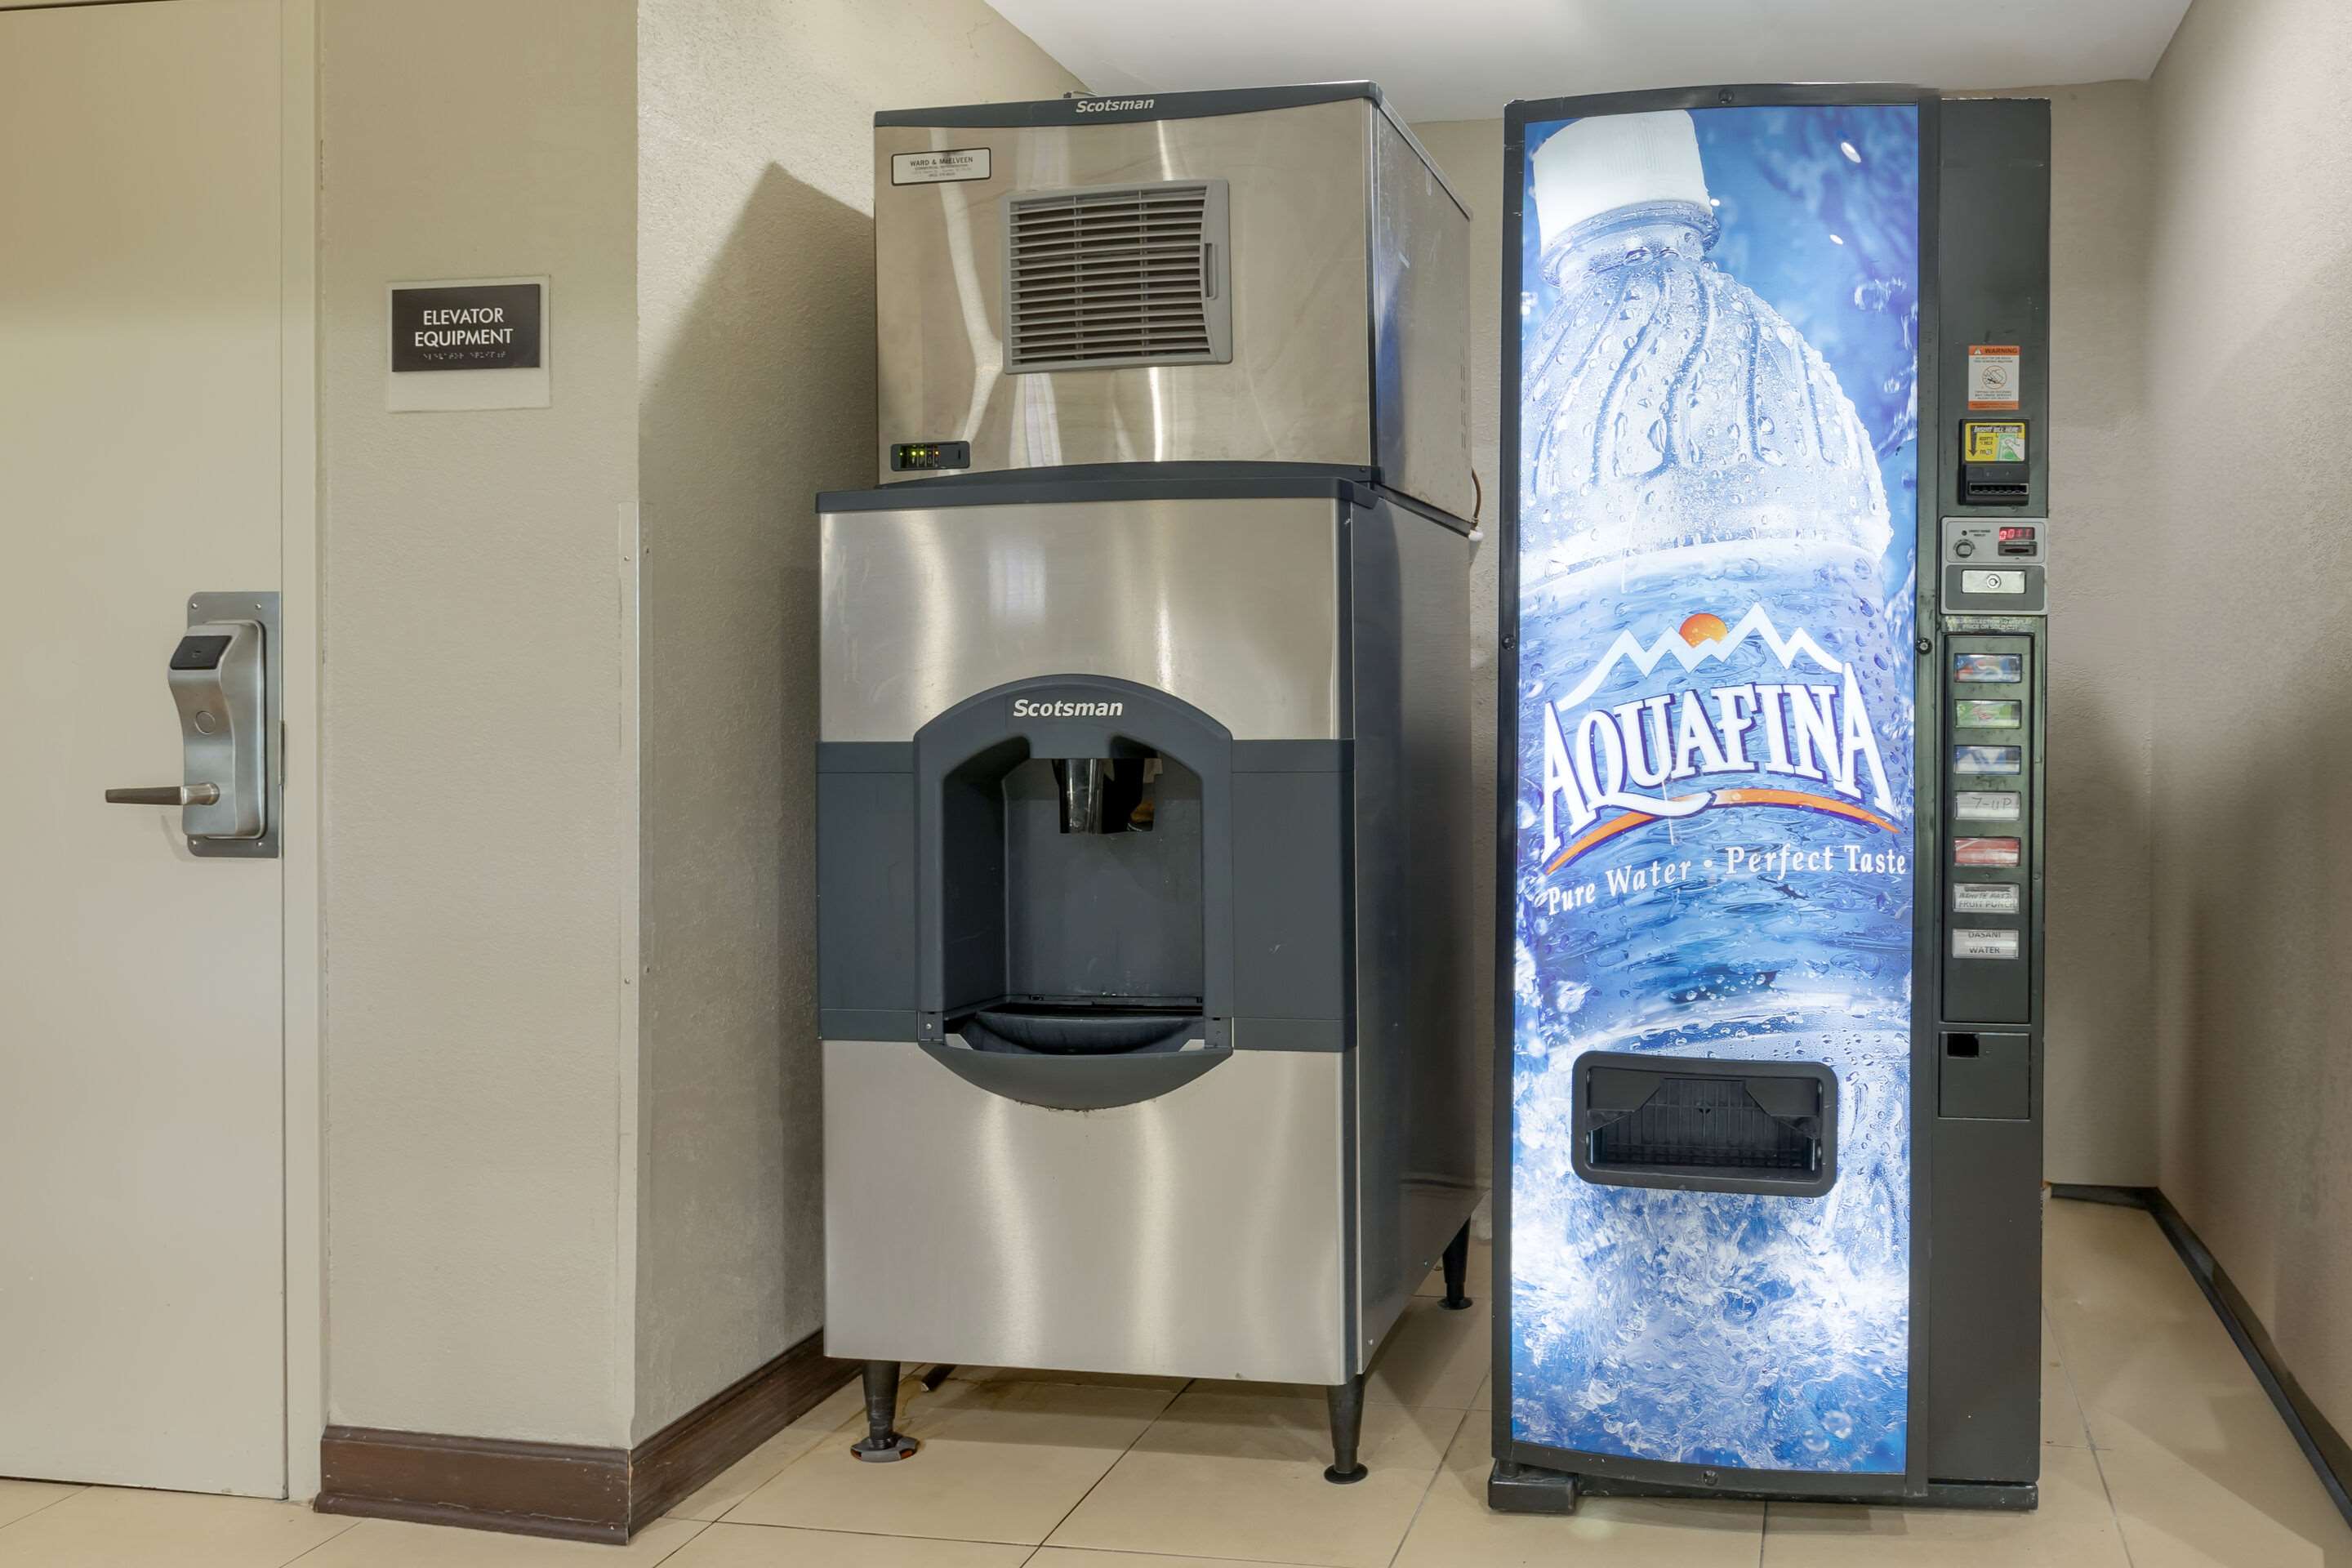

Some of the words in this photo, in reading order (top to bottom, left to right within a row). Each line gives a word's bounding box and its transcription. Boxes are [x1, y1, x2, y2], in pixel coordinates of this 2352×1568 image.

[1076, 99, 1154, 113] Scotsman
[910, 158, 929, 167] WARD
[423, 308, 504, 325] ELEVATOR
[415, 328, 514, 347] EQUIPMENT
[1013, 699, 1123, 717] Scotsman
[1541, 662, 1902, 864] AQUAFINA
[1547, 880, 1596, 915] Pure
[1606, 858, 1692, 895] Water
[1725, 844, 1834, 880] Perfect
[1843, 845, 1906, 875] Taste
